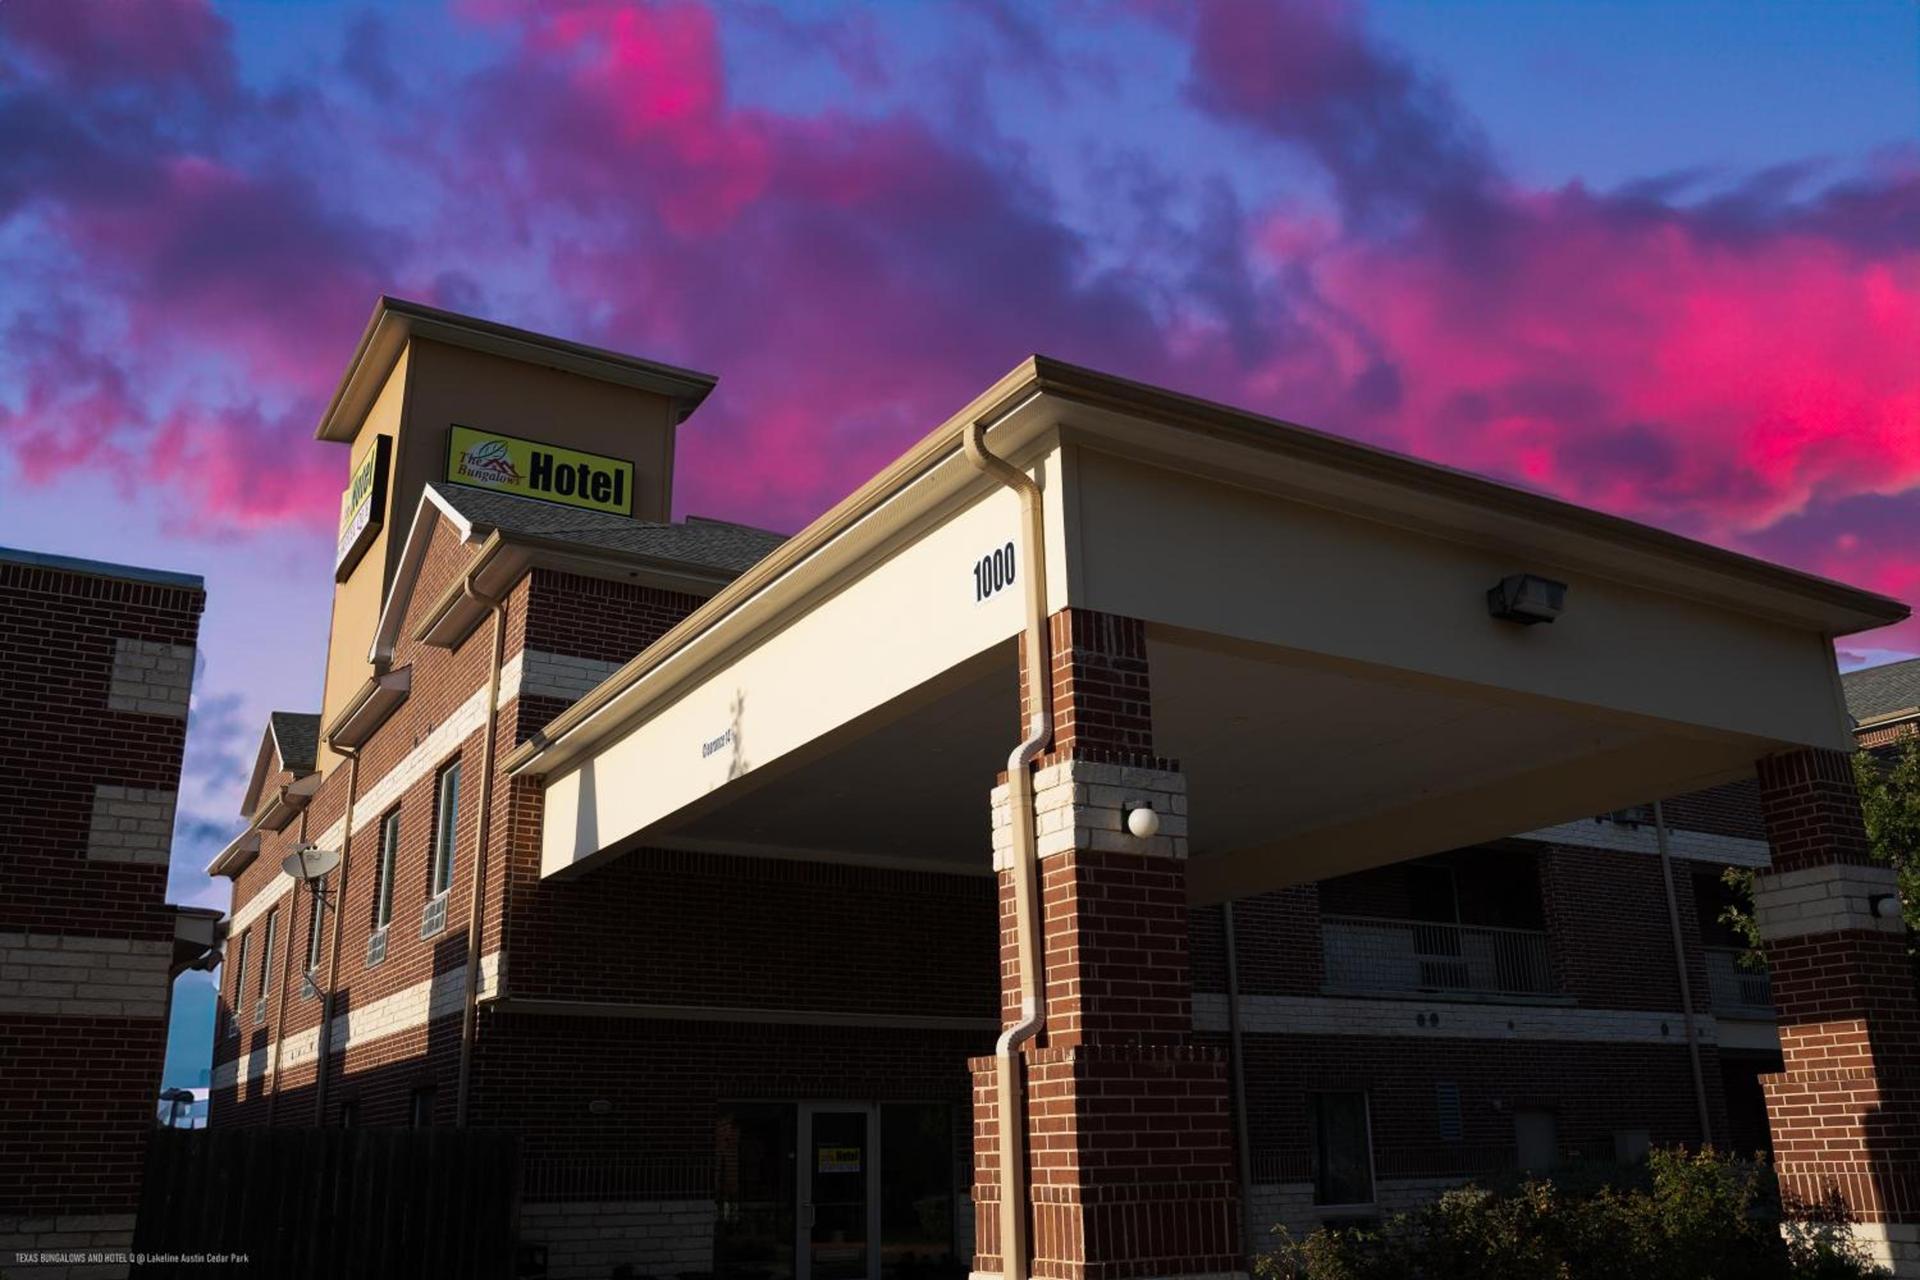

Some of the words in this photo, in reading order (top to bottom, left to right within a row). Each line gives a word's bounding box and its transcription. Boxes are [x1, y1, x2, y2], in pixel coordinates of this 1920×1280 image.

[458, 463, 520, 486] Bungalows
[459, 451, 482, 466] The
[529, 451, 625, 506] Hotel
[973, 541, 1016, 602] 1000
